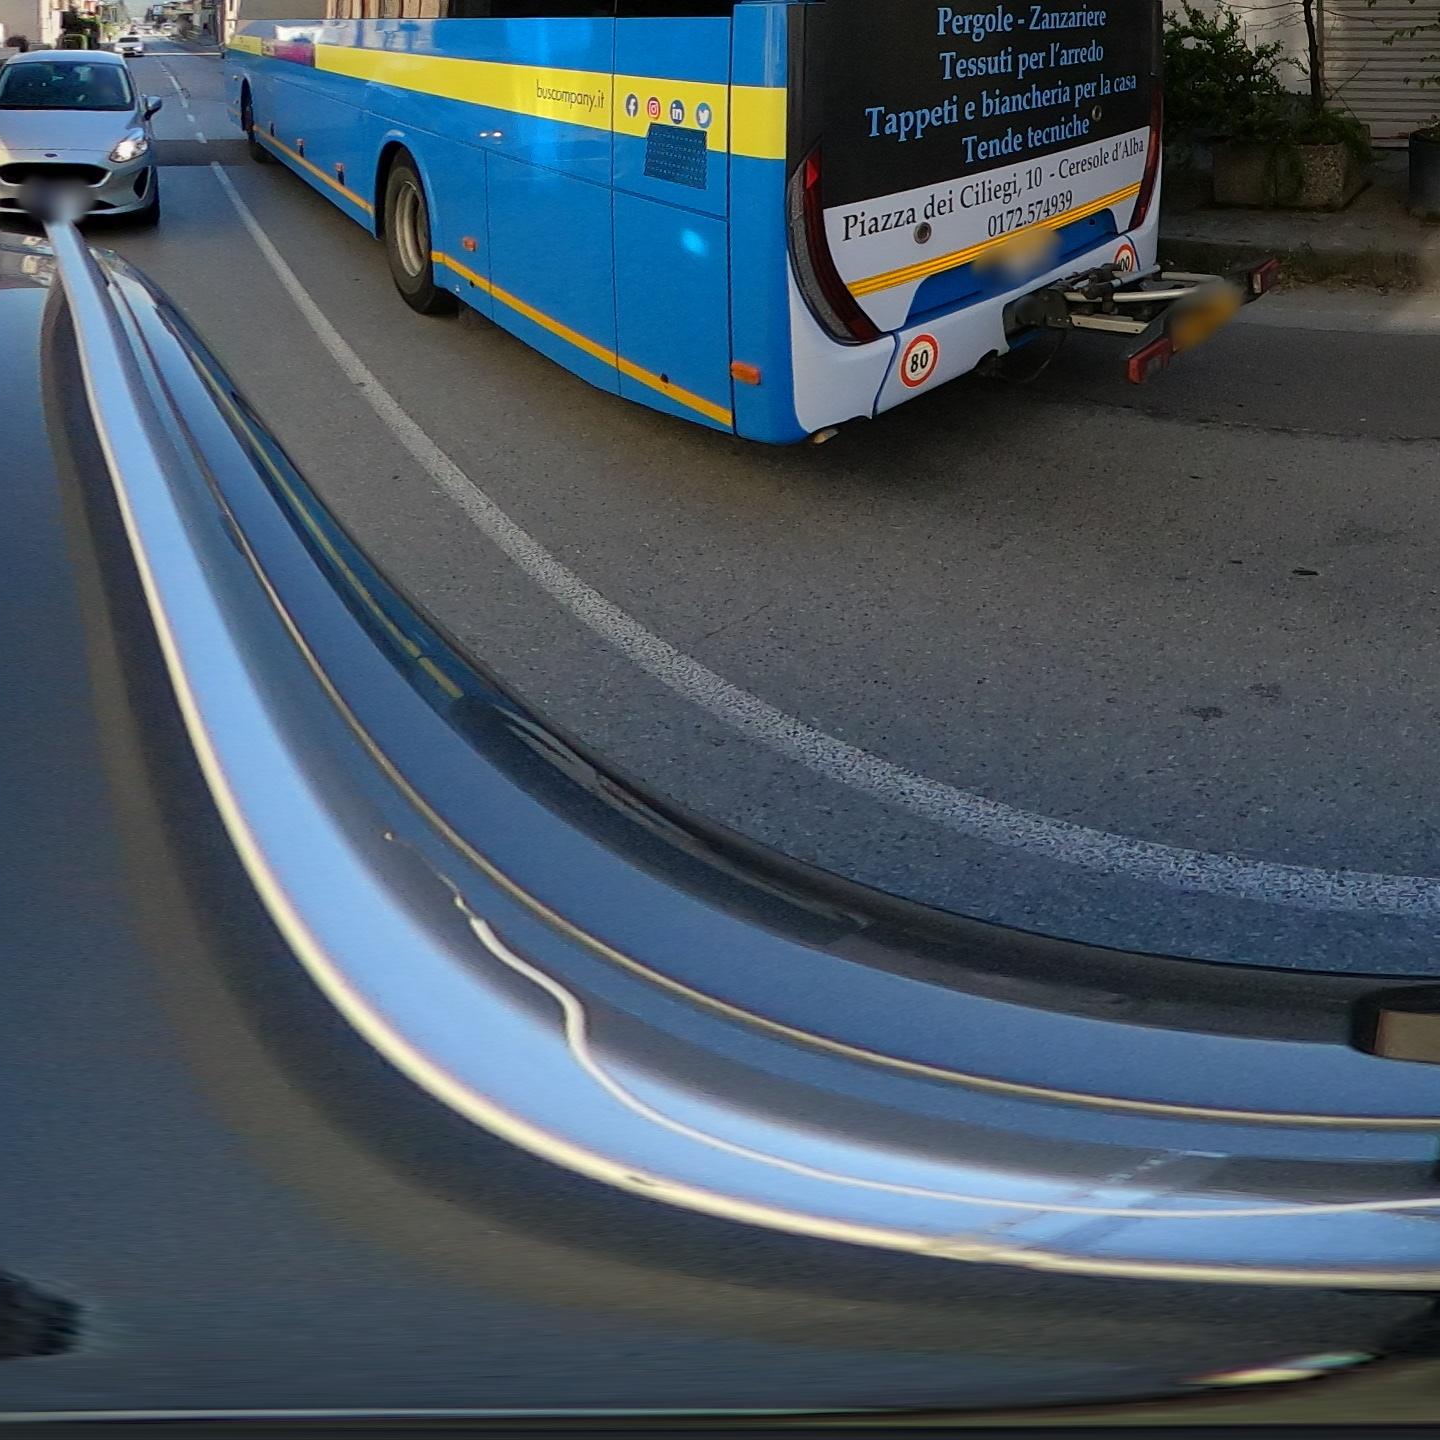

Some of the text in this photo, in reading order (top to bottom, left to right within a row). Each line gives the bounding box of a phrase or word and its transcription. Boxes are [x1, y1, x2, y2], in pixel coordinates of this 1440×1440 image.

[937, 5, 1013, 42] Pergole
[1029, 4, 1107, 31] Zanzariere
[939, 39, 1104, 80] Tessuti per l'arredo
[536, 78, 605, 113] buscompany.it
[865, 73, 1137, 142] Tappeti e biancheria per la casa
[962, 113, 1090, 164] Tende tecniche
[842, 207, 916, 242] Piazza
[923, 191, 954, 221] dei
[960, 176, 1024, 210] Ciliegi,
[1025, 166, 1043, 191] 10
[1058, 149, 1110, 180] Ceresole
[1112, 136, 1145, 162] d'Alba
[987, 190, 1074, 238] 0172.574939
[910, 349, 929, 374] 80
